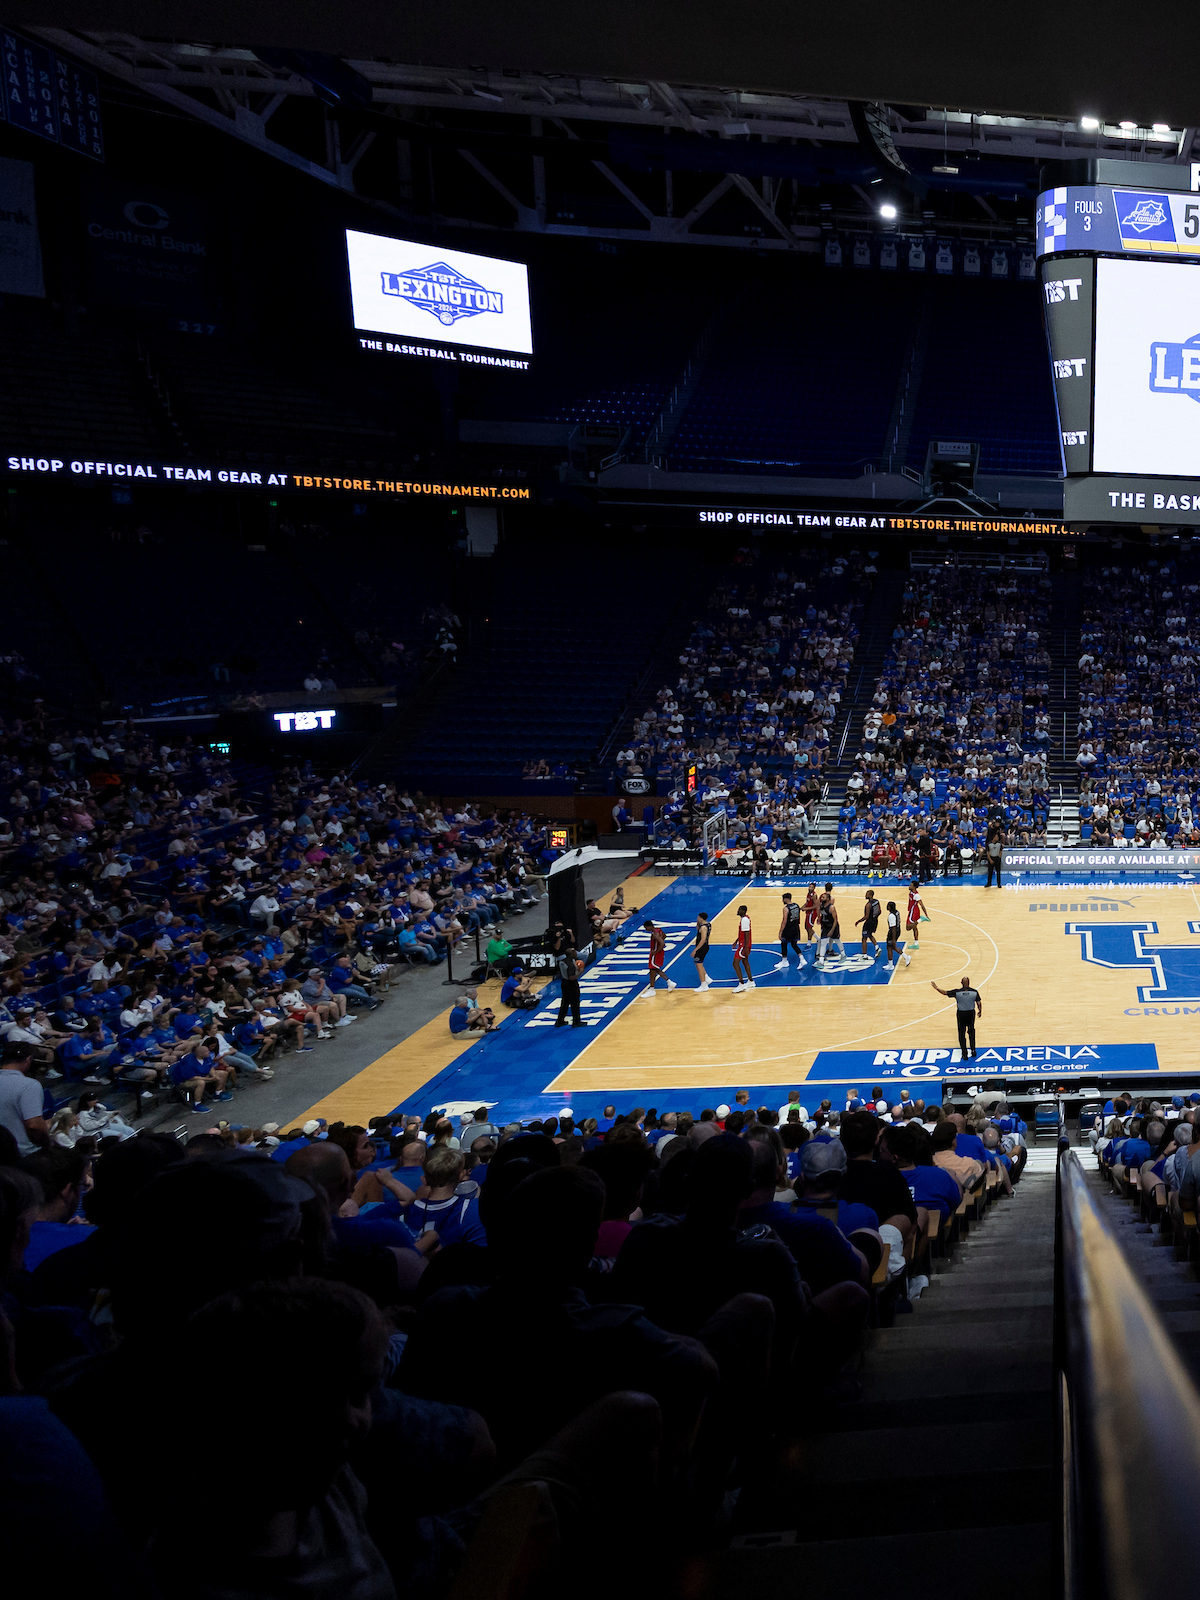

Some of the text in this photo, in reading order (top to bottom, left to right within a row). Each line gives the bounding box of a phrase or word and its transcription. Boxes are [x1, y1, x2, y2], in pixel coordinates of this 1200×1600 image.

[1074, 200, 1103, 215] FOULS
[0, 210, 31, 226] ank
[1083, 215, 1092, 232] 3
[430, 272, 457, 284] TBT
[382, 273, 503, 313] LEXINGTON
[359, 338, 530, 370] THE BASKETBALL TOURNAMENT
[8, 457, 530, 499] SHOP OFFICIAL TEAM GEAR AT TBTSTORE.THETOURNAMENT.COM
[1108, 491, 1146, 509] THE
[699, 511, 1085, 535] SHOP OFFICIAL TEAM GEAR AT TBTSTORE.THETOURNAMENT.C
[273, 709, 337, 732] TBT
[551, 837, 565, 846] 24
[1005, 855, 1053, 865] OFFICIAL
[1056, 855, 1085, 865] TEAM
[1088, 855, 1116, 865] GEAR
[1118, 855, 1174, 865] AVAILABLE
[1177, 855, 1190, 865] AT
[975, 1045, 1099, 1062] ARENA
[944, 1065, 999, 1074] Central
[1001, 1063, 1039, 1073] Bank
[1041, 1062, 1090, 1072] Center
